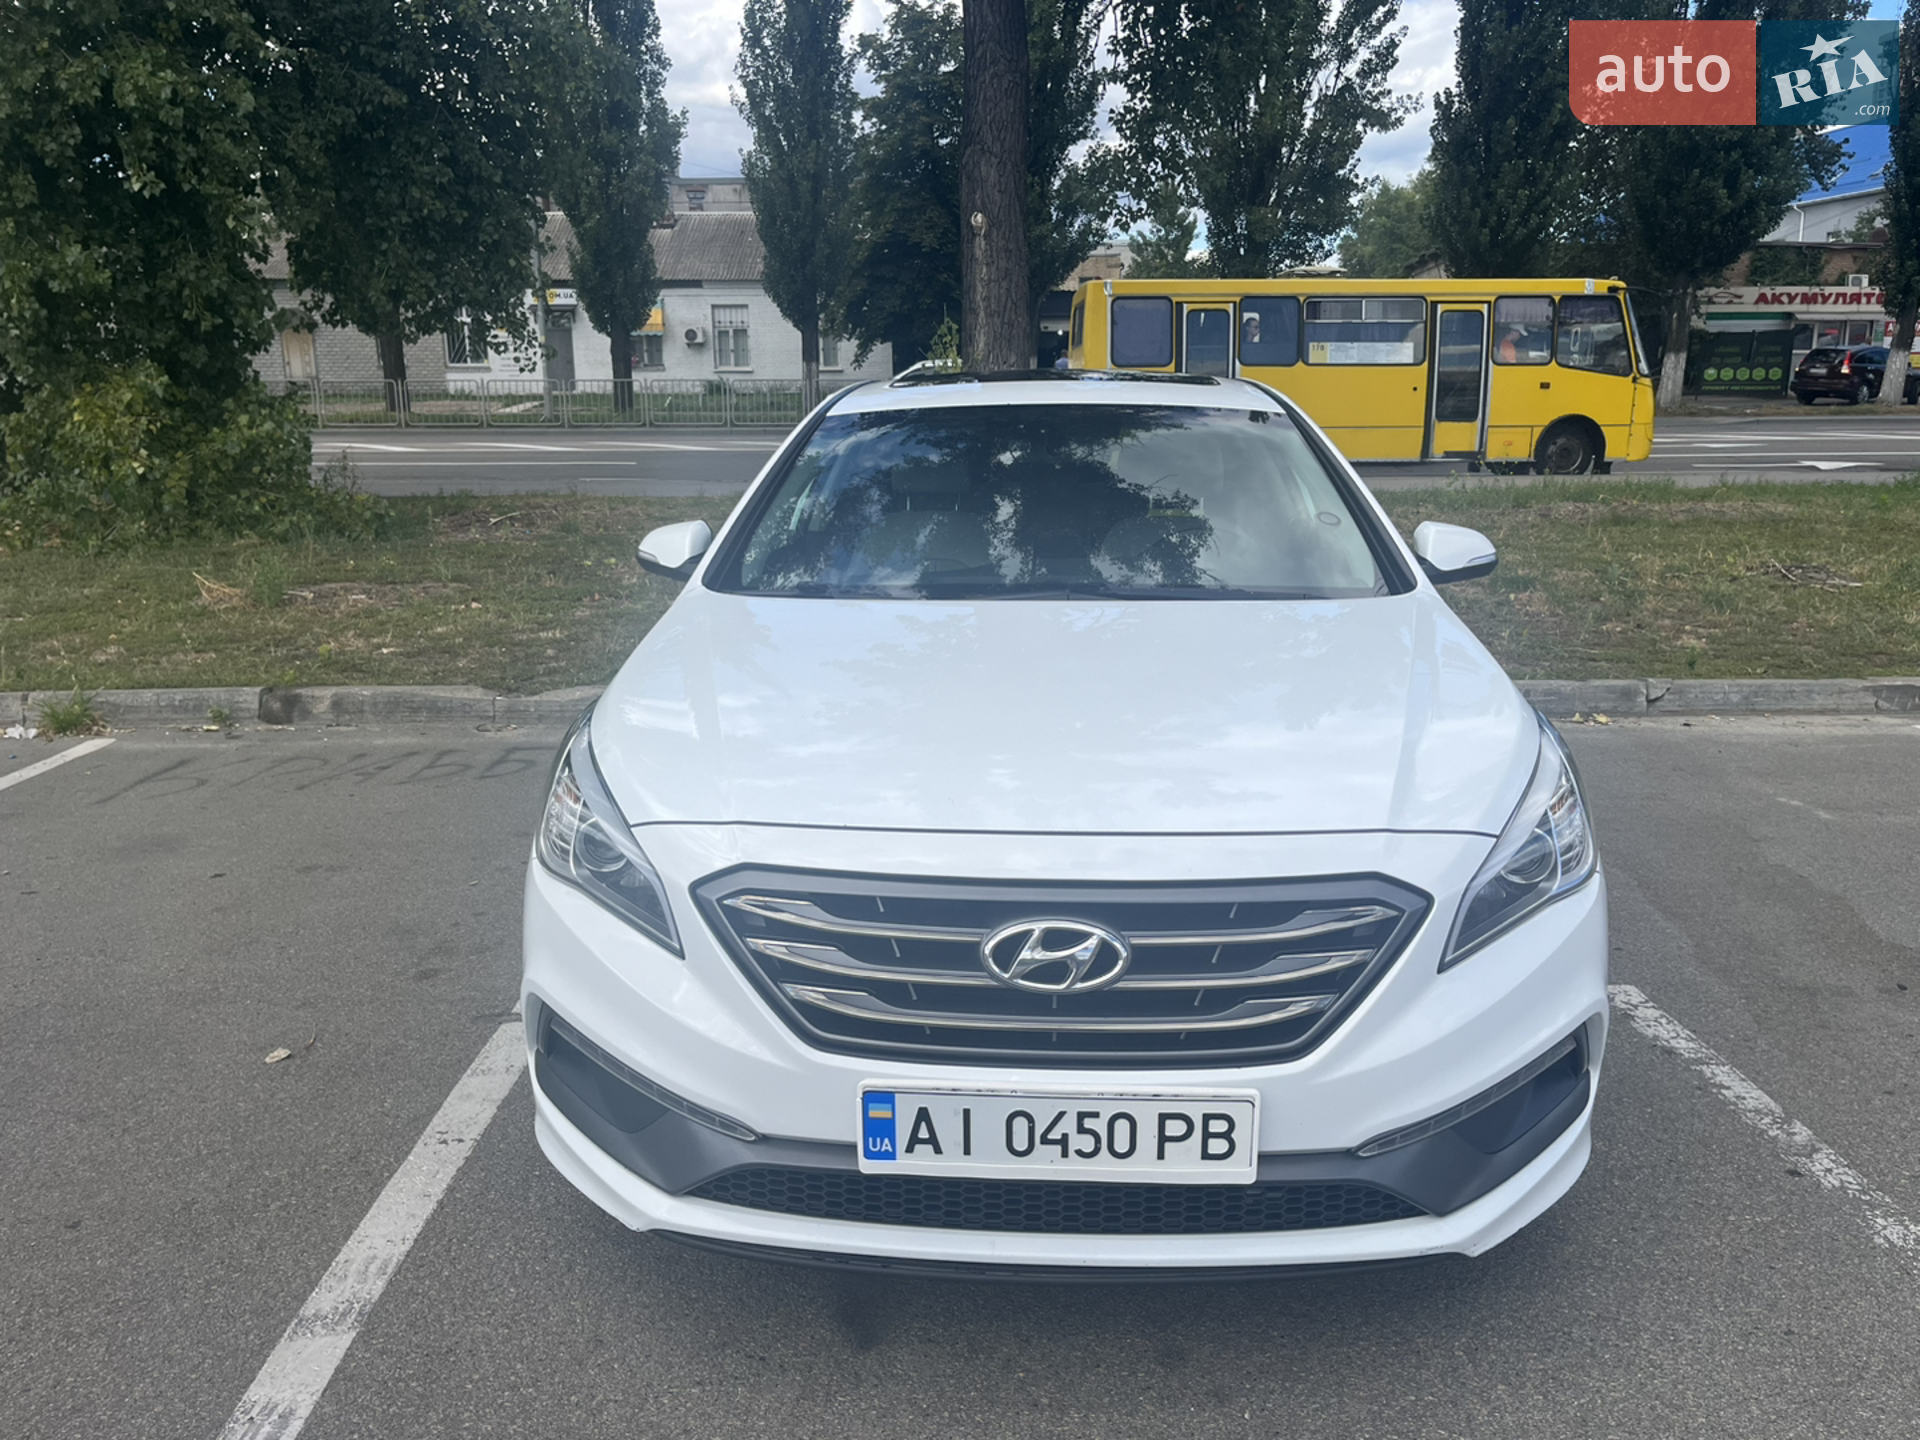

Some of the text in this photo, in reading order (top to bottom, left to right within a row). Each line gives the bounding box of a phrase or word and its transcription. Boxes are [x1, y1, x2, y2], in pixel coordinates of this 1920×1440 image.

[1754, 292, 1886, 305] АКУМУЛЯТО
[904, 1106, 1237, 1161] AI 0450 PB
[868, 1137, 893, 1153] UA
